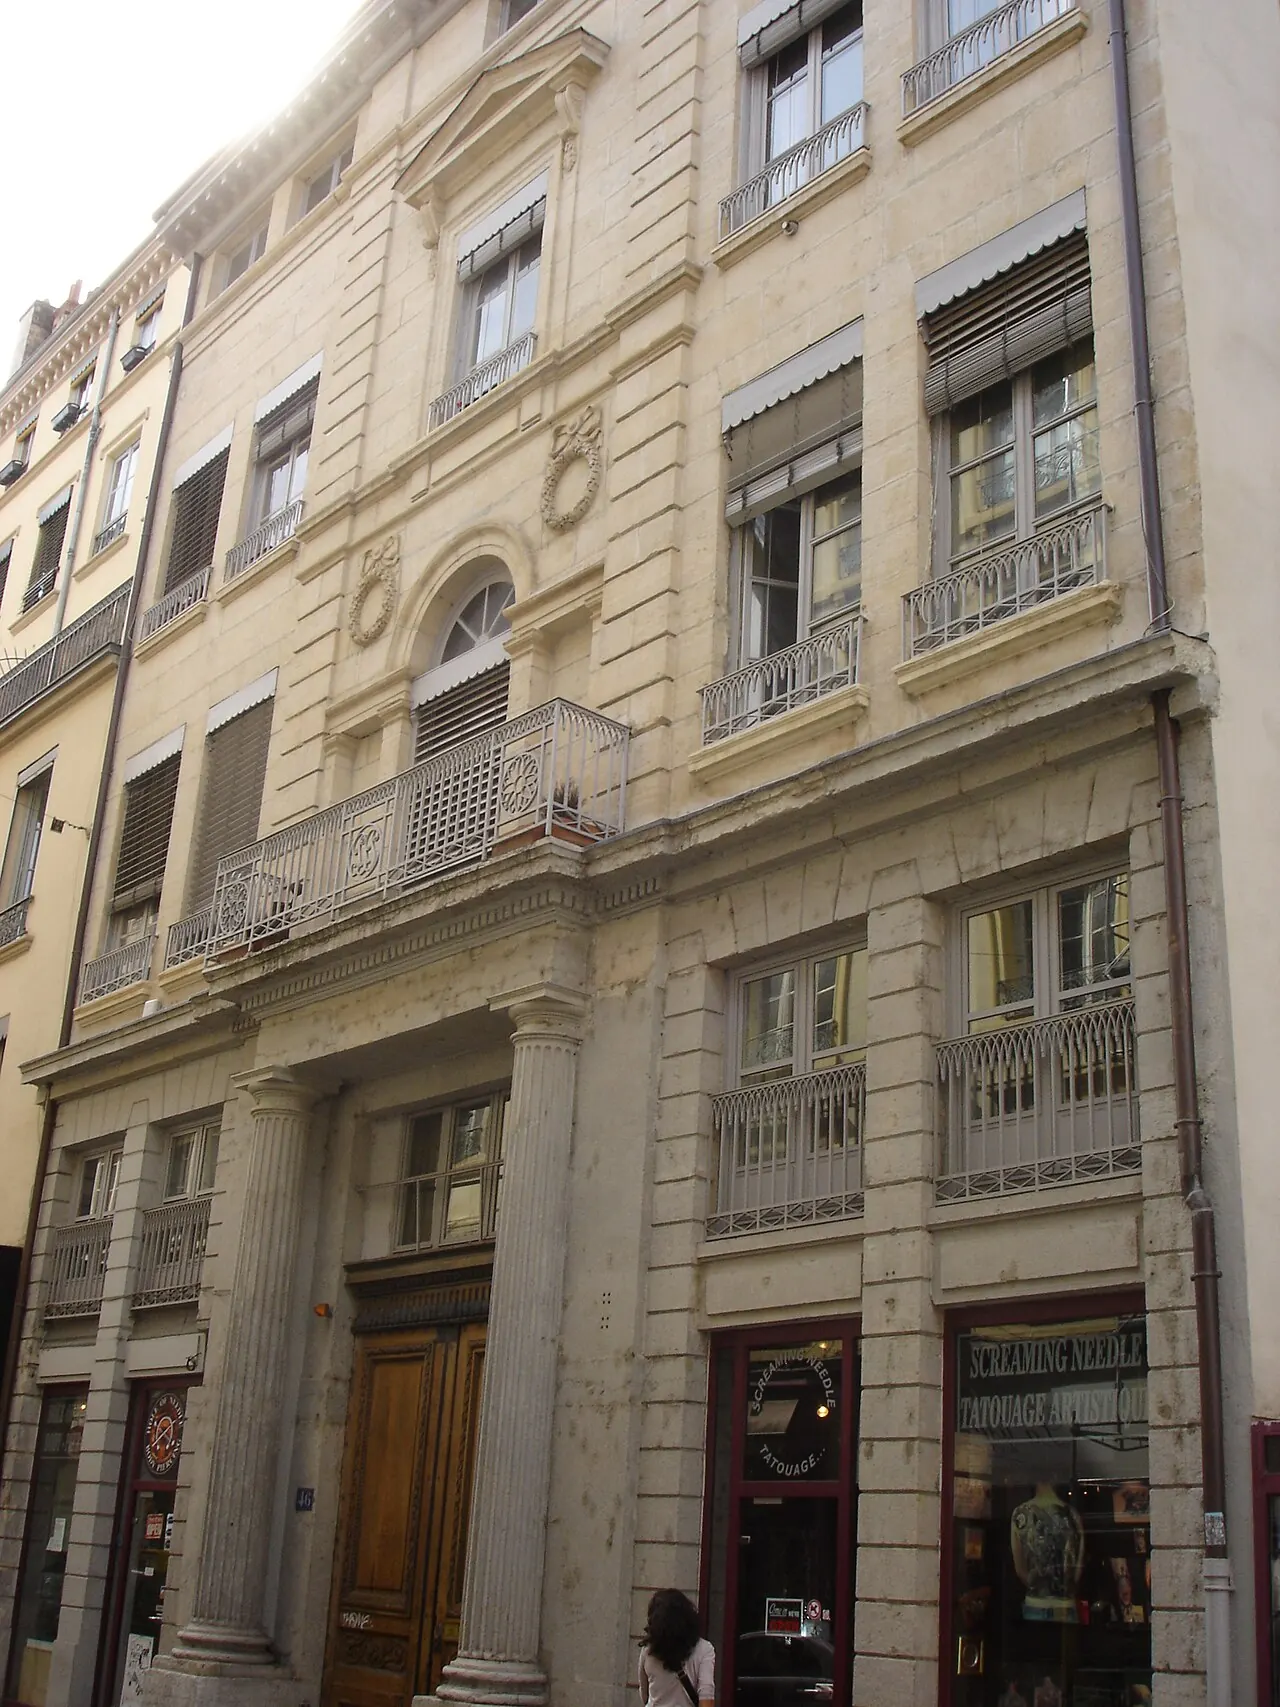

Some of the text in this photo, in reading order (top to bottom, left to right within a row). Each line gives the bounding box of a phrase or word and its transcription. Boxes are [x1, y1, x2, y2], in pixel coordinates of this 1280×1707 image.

[970, 1332, 1143, 1378] SCREAMING NEEDLE
[752, 1350, 836, 1412] SCREAMING NEEDLE
[960, 1392, 1047, 1429] TATOUAGE
